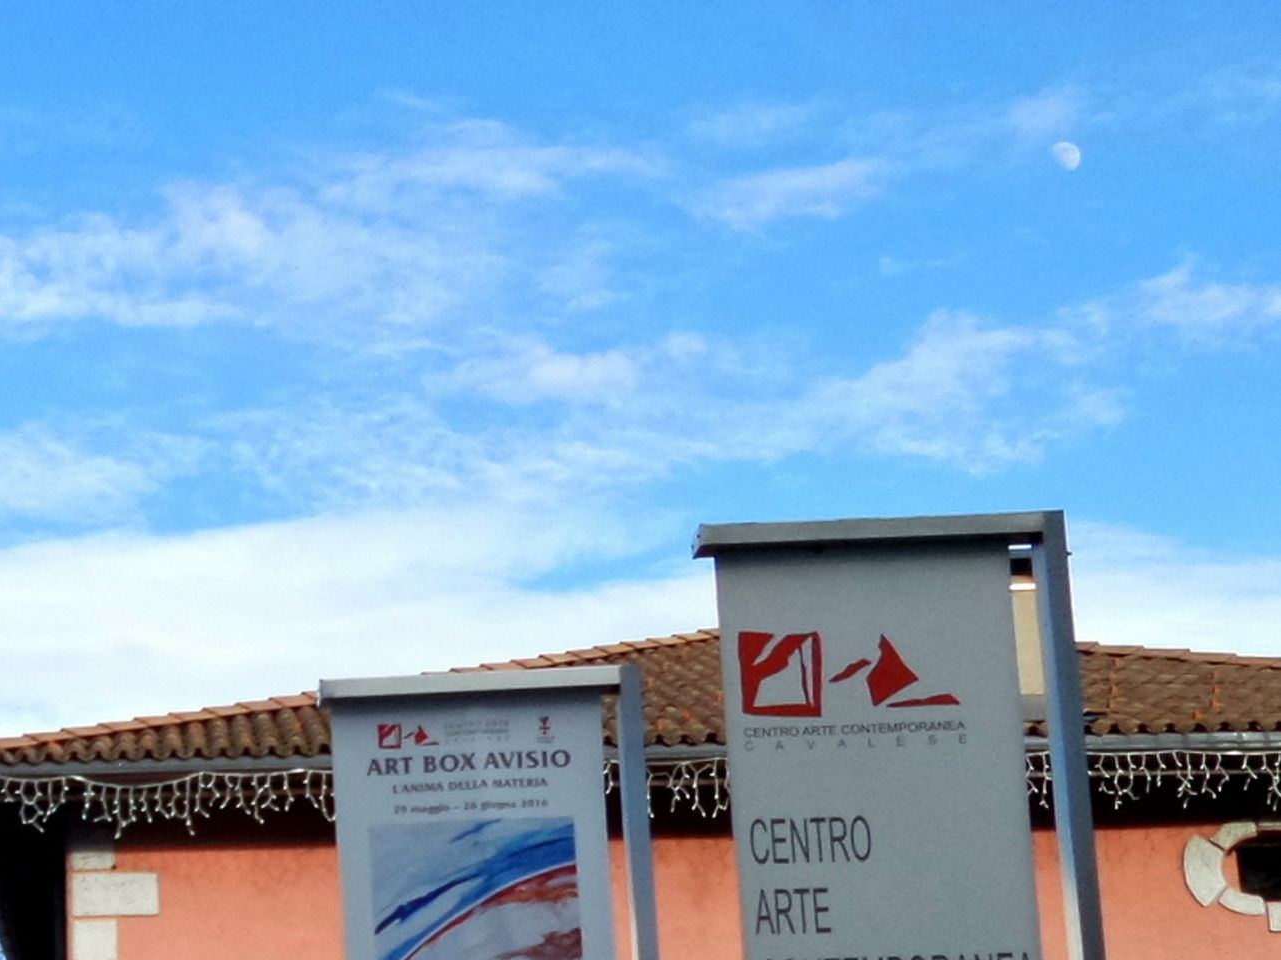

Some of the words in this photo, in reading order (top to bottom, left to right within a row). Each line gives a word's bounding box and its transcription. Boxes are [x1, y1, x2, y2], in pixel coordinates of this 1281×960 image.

[744, 726, 799, 738] CENTRO
[802, 725, 836, 737] ARTE
[841, 721, 966, 736] CONTEMPORANEA
[367, 756, 413, 776] ART
[423, 753, 477, 773] BOX
[483, 749, 571, 770] AVISIO
[448, 780, 488, 791] DELLA
[492, 778, 548, 789] MATERIA
[749, 816, 872, 864] CENTRO
[755, 887, 832, 935] ARTE
